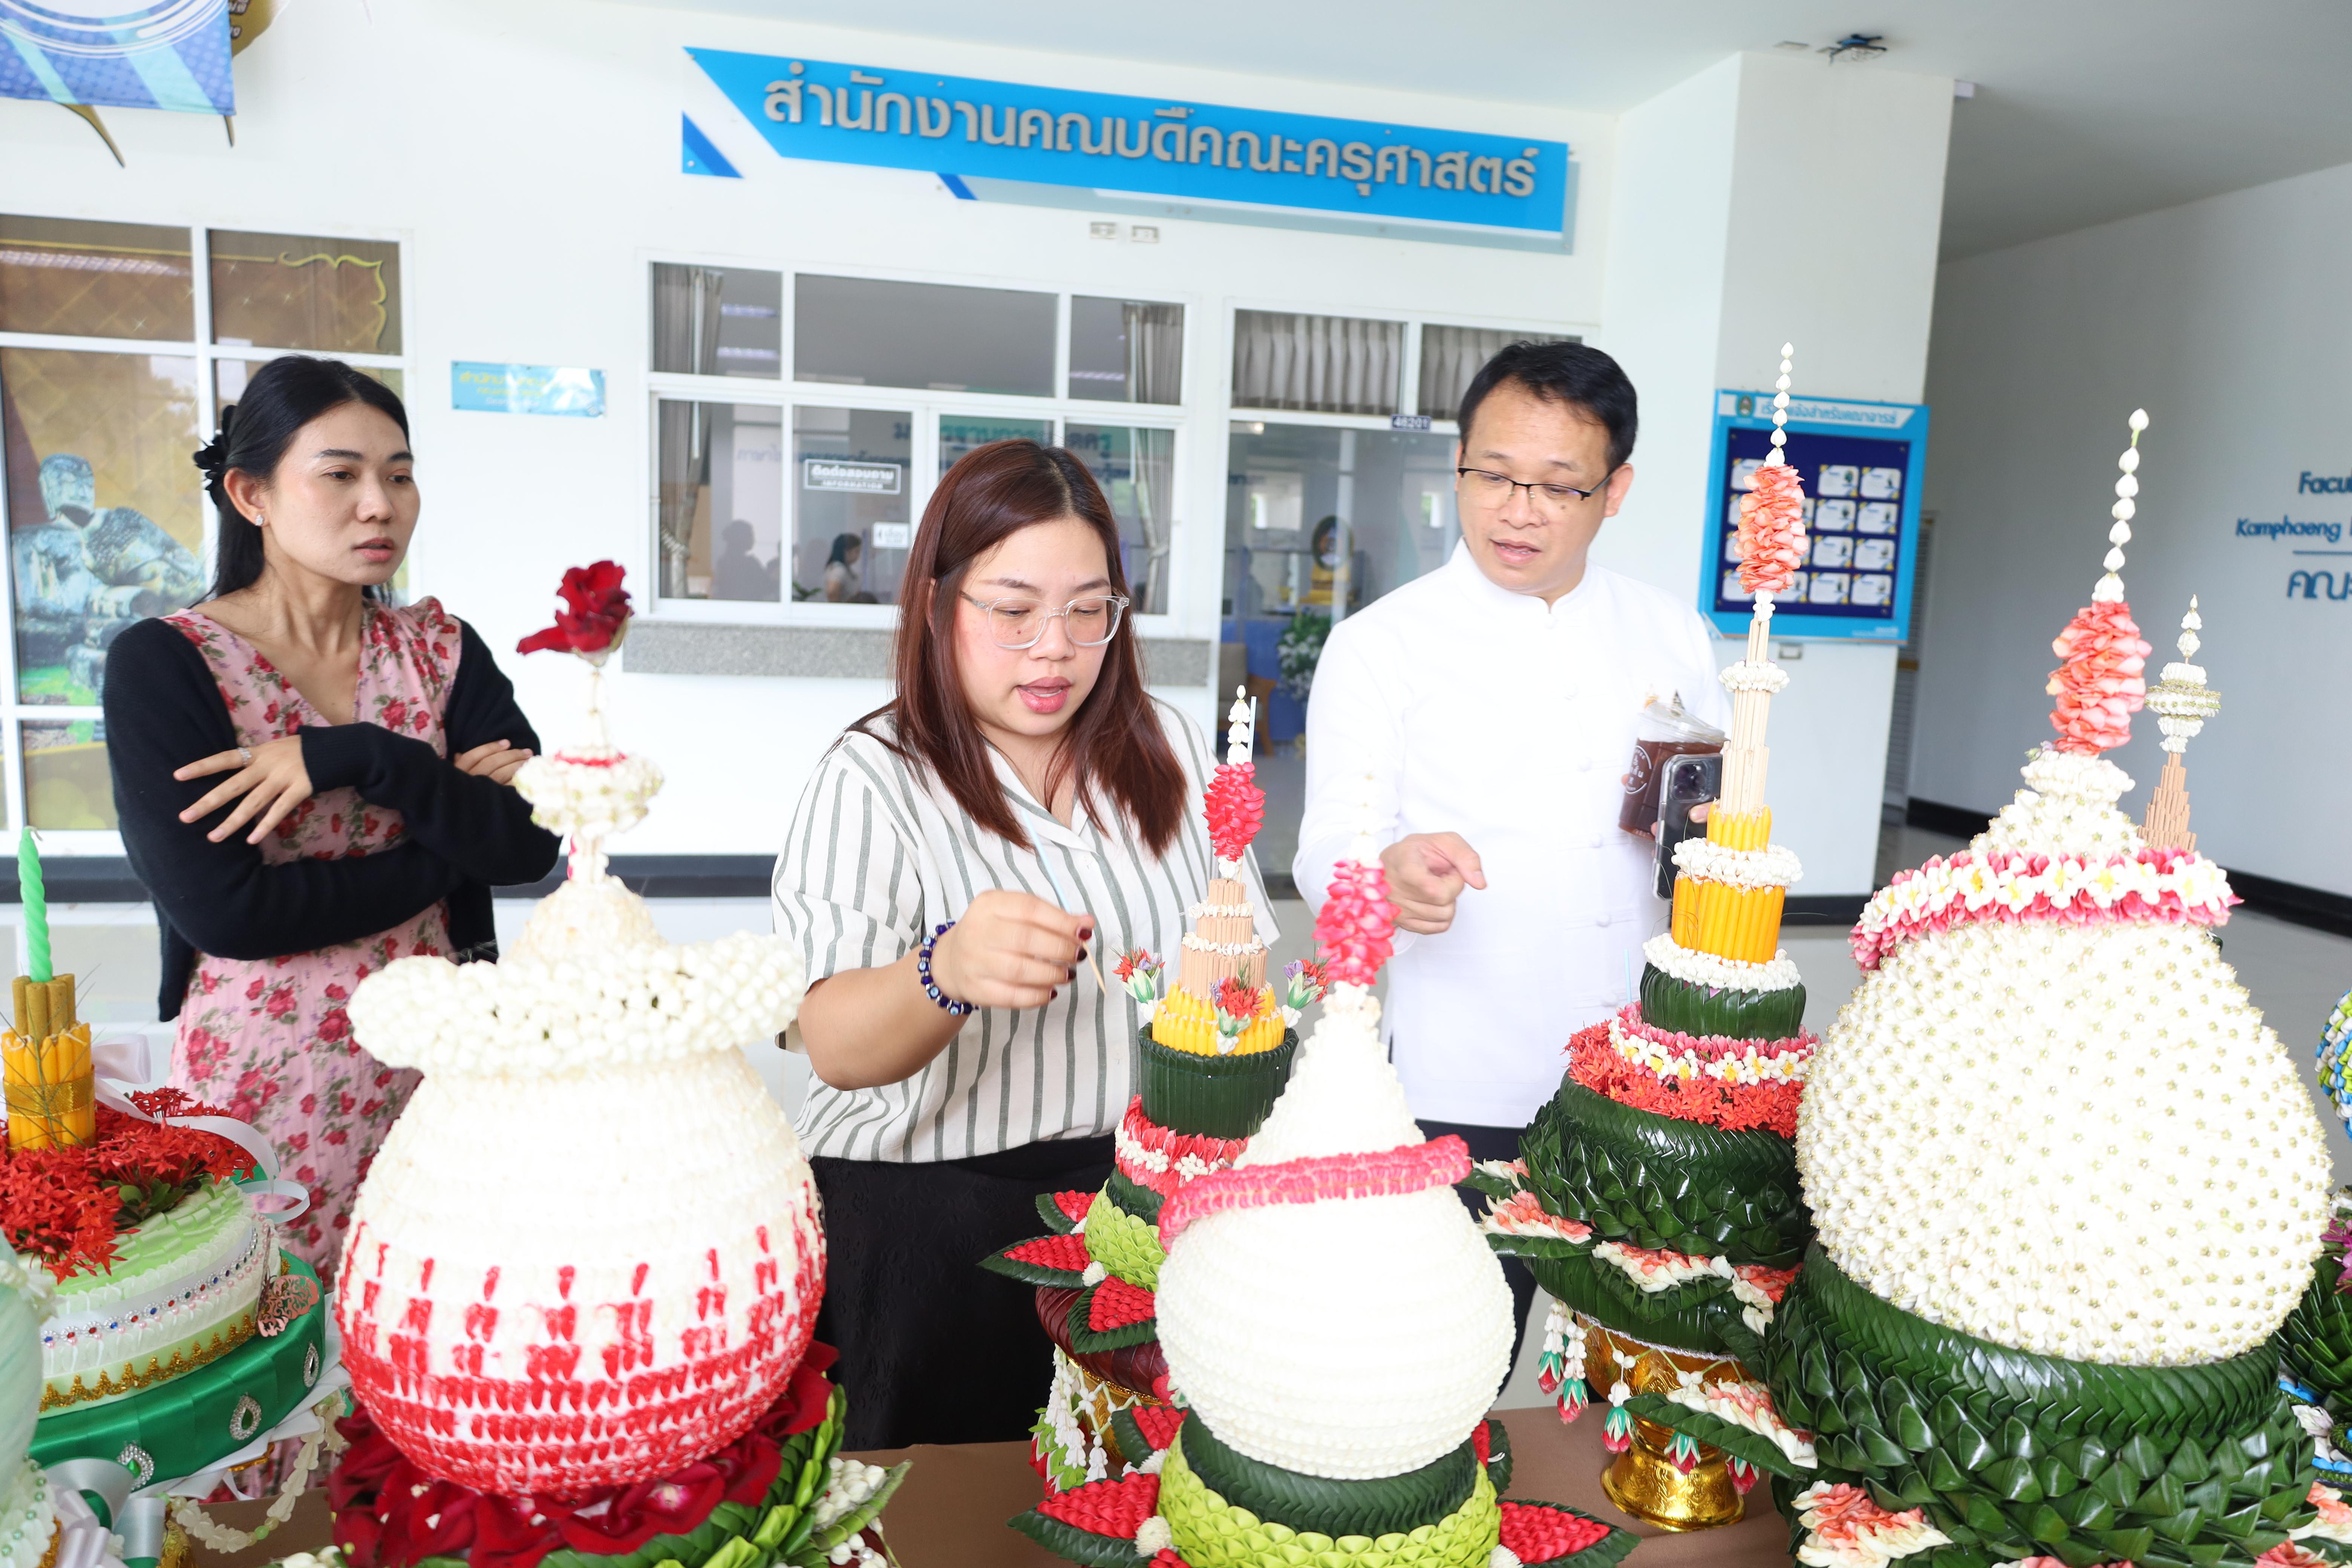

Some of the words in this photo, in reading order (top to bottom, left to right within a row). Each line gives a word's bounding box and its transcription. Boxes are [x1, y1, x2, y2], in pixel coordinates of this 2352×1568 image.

[764, 61, 1539, 198] สำนักงานคณบดีคณะครุศาสตร์
[2299, 471, 2352, 494] Facu
[2236, 514, 2341, 543] Kamphaeng
